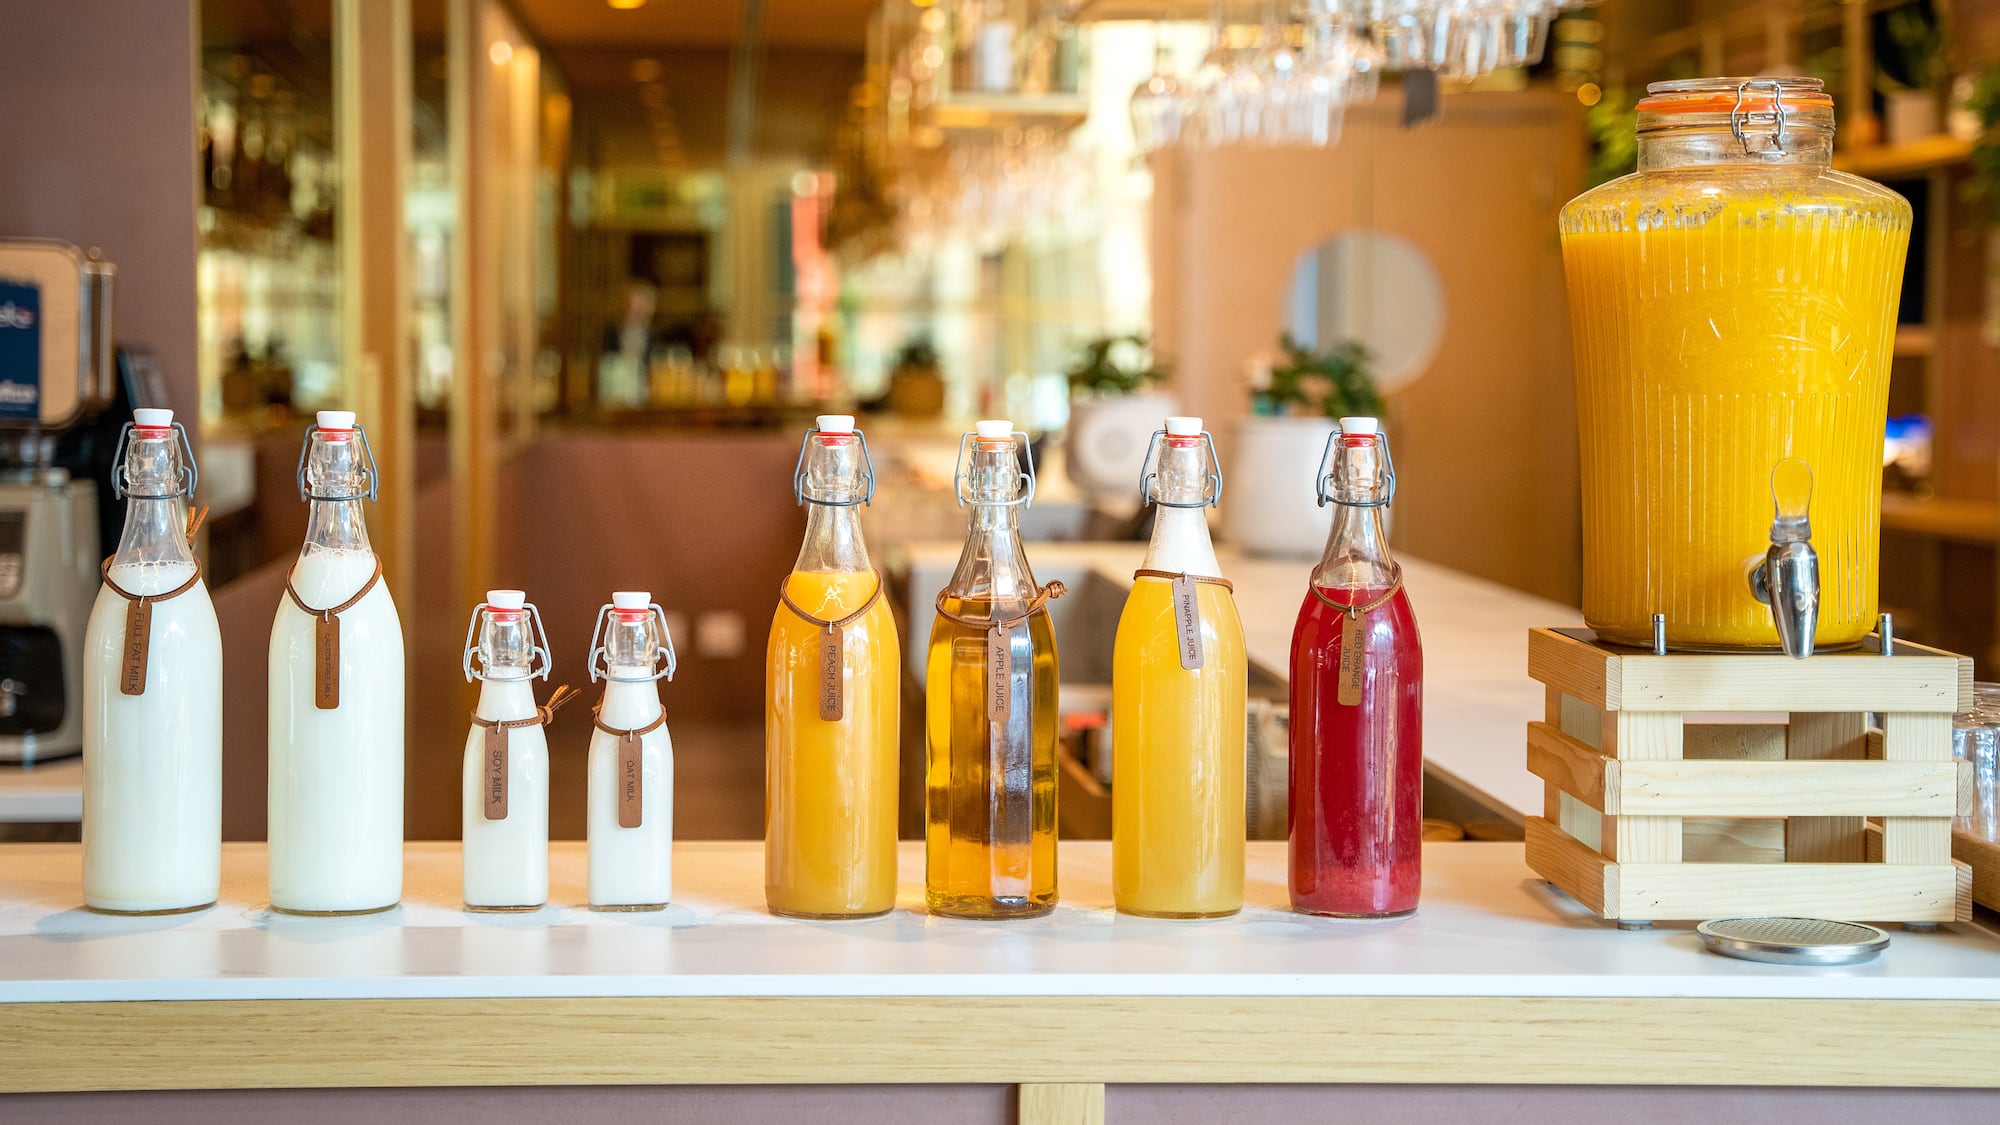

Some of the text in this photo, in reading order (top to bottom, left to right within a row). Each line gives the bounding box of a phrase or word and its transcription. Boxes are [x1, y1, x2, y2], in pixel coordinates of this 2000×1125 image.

[129, 612, 145, 691] FULL FAT MILK
[1183, 594, 1196, 660] PINAPPLE JUICE
[827, 645, 836, 712] PEACH JUICE
[995, 646, 1005, 712] APPLE JUICE
[1342, 647, 1351, 672] JUICE
[1352, 629, 1363, 689] RED ORANGE
[492, 750, 502, 804] SOY MILK
[626, 760, 635, 802] OAT MILK
